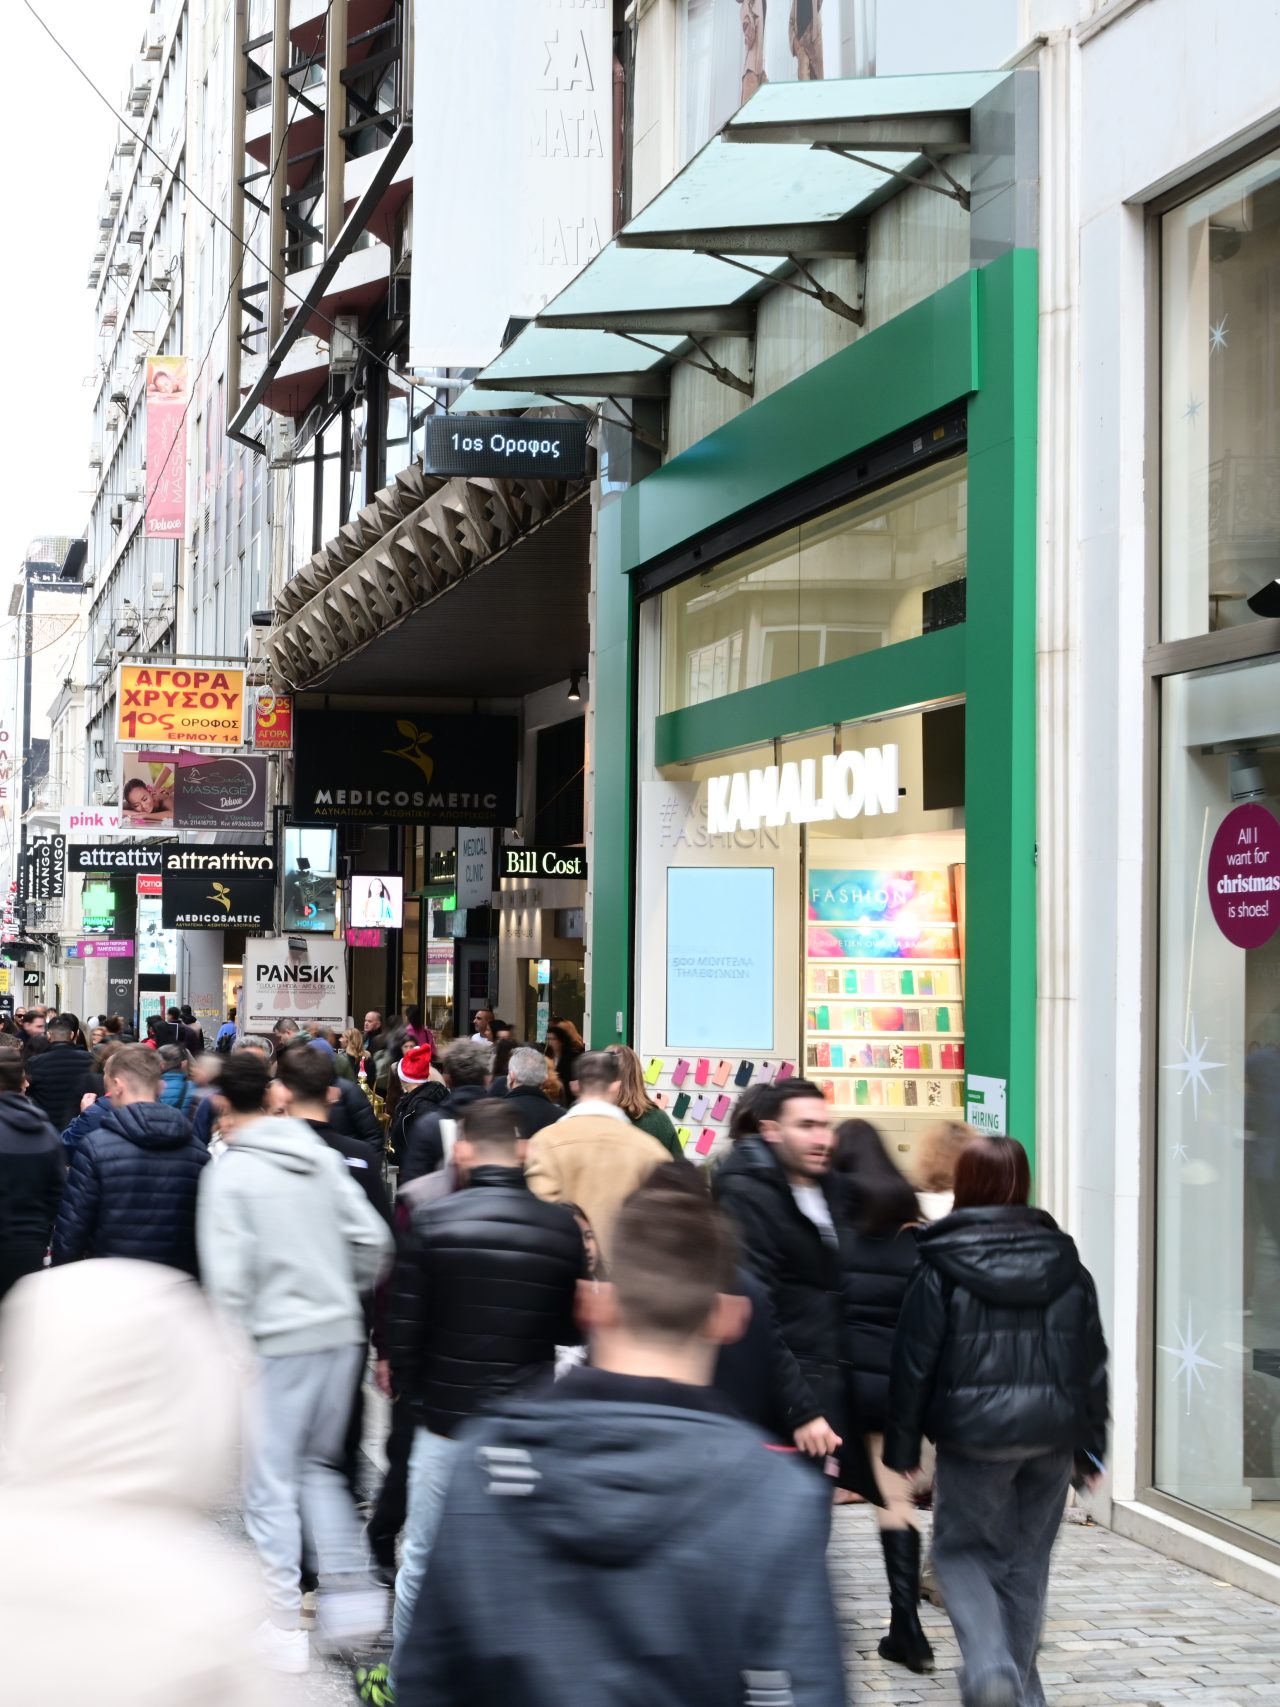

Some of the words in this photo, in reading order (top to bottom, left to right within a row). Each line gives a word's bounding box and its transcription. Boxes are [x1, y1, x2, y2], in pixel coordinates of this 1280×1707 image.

[149, 518, 182, 532] Deluxe
[135, 670, 230, 690] ΑΓΟΡΑ
[123, 689, 240, 710] ΧΡΥΣΟΥ
[181, 718, 239, 729] ΟΡΟΦΟΣ
[168, 732, 218, 741] ΕΡΜΟΥ
[258, 730, 289, 738] ΑΓΟΡΑ
[182, 785, 248, 796] MASSAGE
[707, 743, 899, 834] KAMALION
[220, 797, 243, 808] Deluxe
[315, 788, 497, 809] MEDICOSMETIC
[69, 812, 104, 828] pink
[314, 808, 374, 817] ΑΔΥΝΑΤΙΣΜΑ
[383, 809, 430, 818] ΑΙΣΘΗΤΙΚΗ
[660, 825, 780, 849] FASHION
[1238, 827, 1252, 845] All
[1254, 827, 1258, 843] I
[79, 846, 162, 867] attrattiv
[463, 837, 487, 857] MEDICAL
[1226, 850, 1252, 866] want
[1254, 847, 1270, 864] for
[53, 837, 64, 894] MANGO
[167, 850, 273, 870] attrattivo
[506, 851, 538, 873] Bill
[542, 852, 582, 874] Cost
[41, 846, 50, 898] MANGO
[465, 863, 484, 883] CLINIC
[1217, 873, 1280, 894] christmas
[812, 889, 907, 904] FASHION
[176, 914, 261, 923] MEDICOSMETIC
[1228, 901, 1236, 918] is
[1237, 900, 1270, 918] shoes!
[24, 974, 38, 984] JD
[971, 1110, 1000, 1130] HIRING
